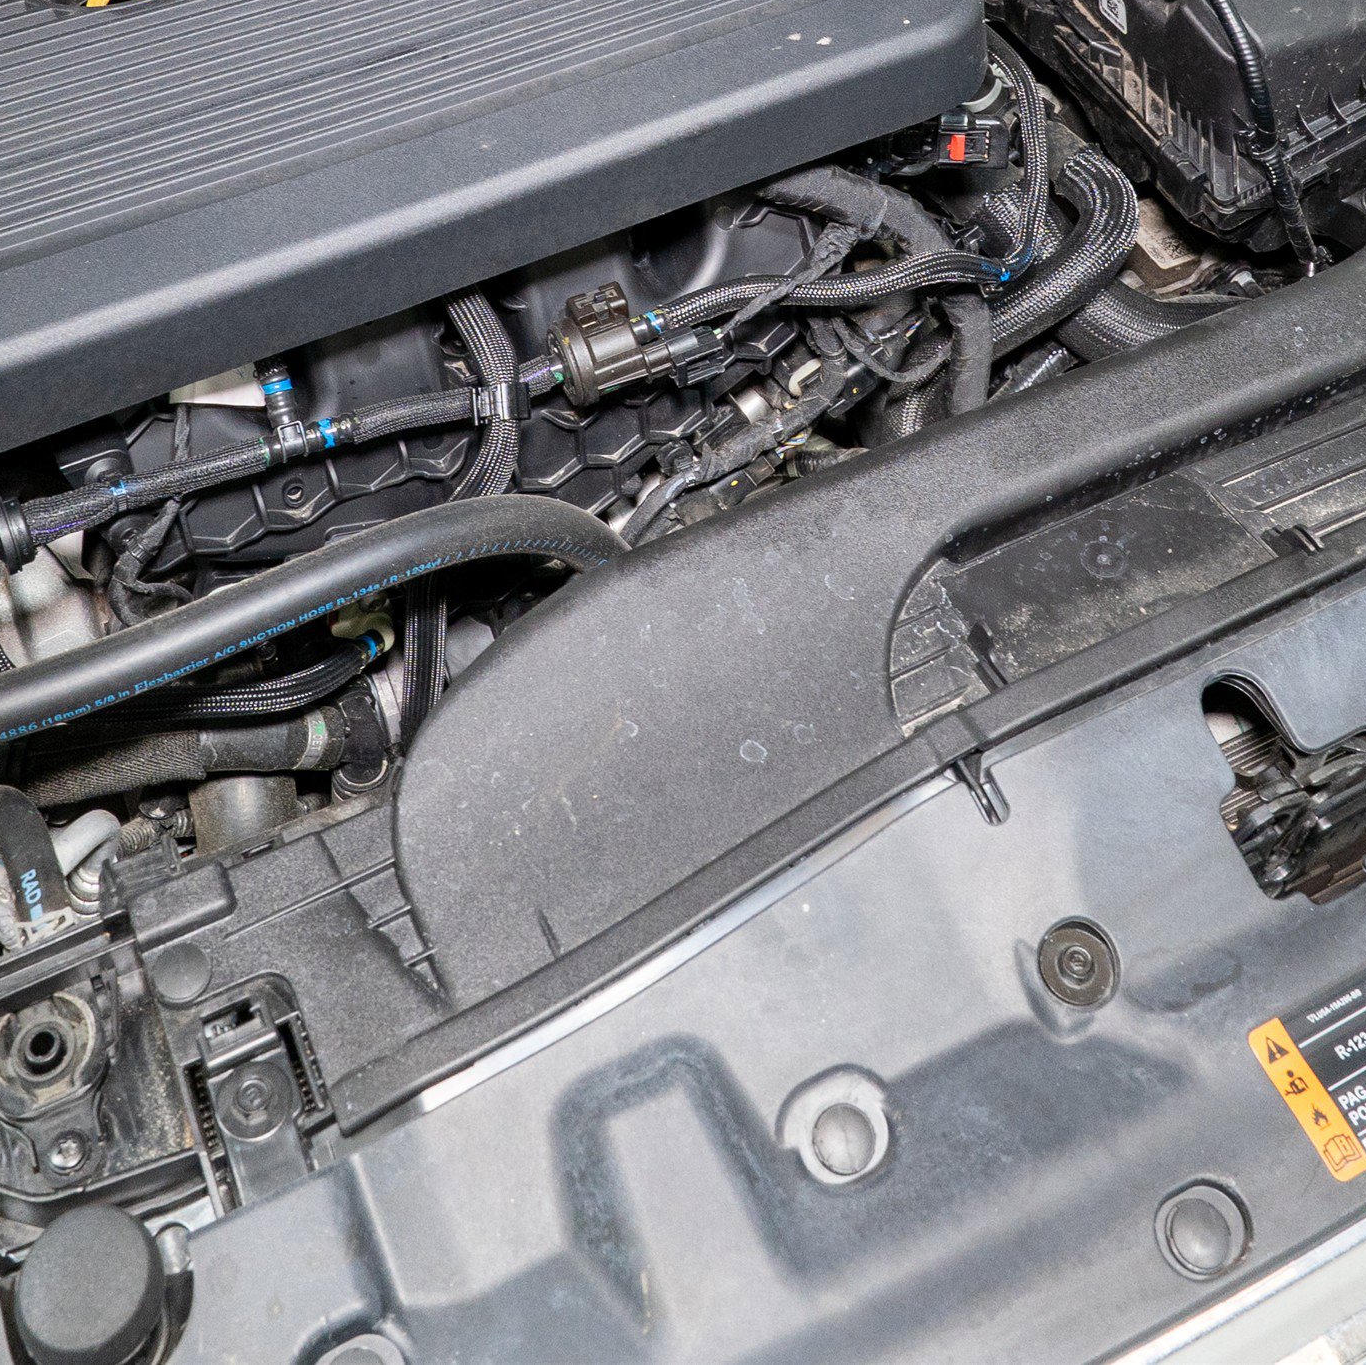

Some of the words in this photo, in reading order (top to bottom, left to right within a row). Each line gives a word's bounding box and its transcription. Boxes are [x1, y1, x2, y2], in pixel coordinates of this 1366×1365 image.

[118, 689, 131, 699] in
[214, 644, 236, 660] A/C
[239, 618, 296, 648] SUCTION
[298, 601, 334, 623] HOSE
[20, 869, 42, 906] RAD
